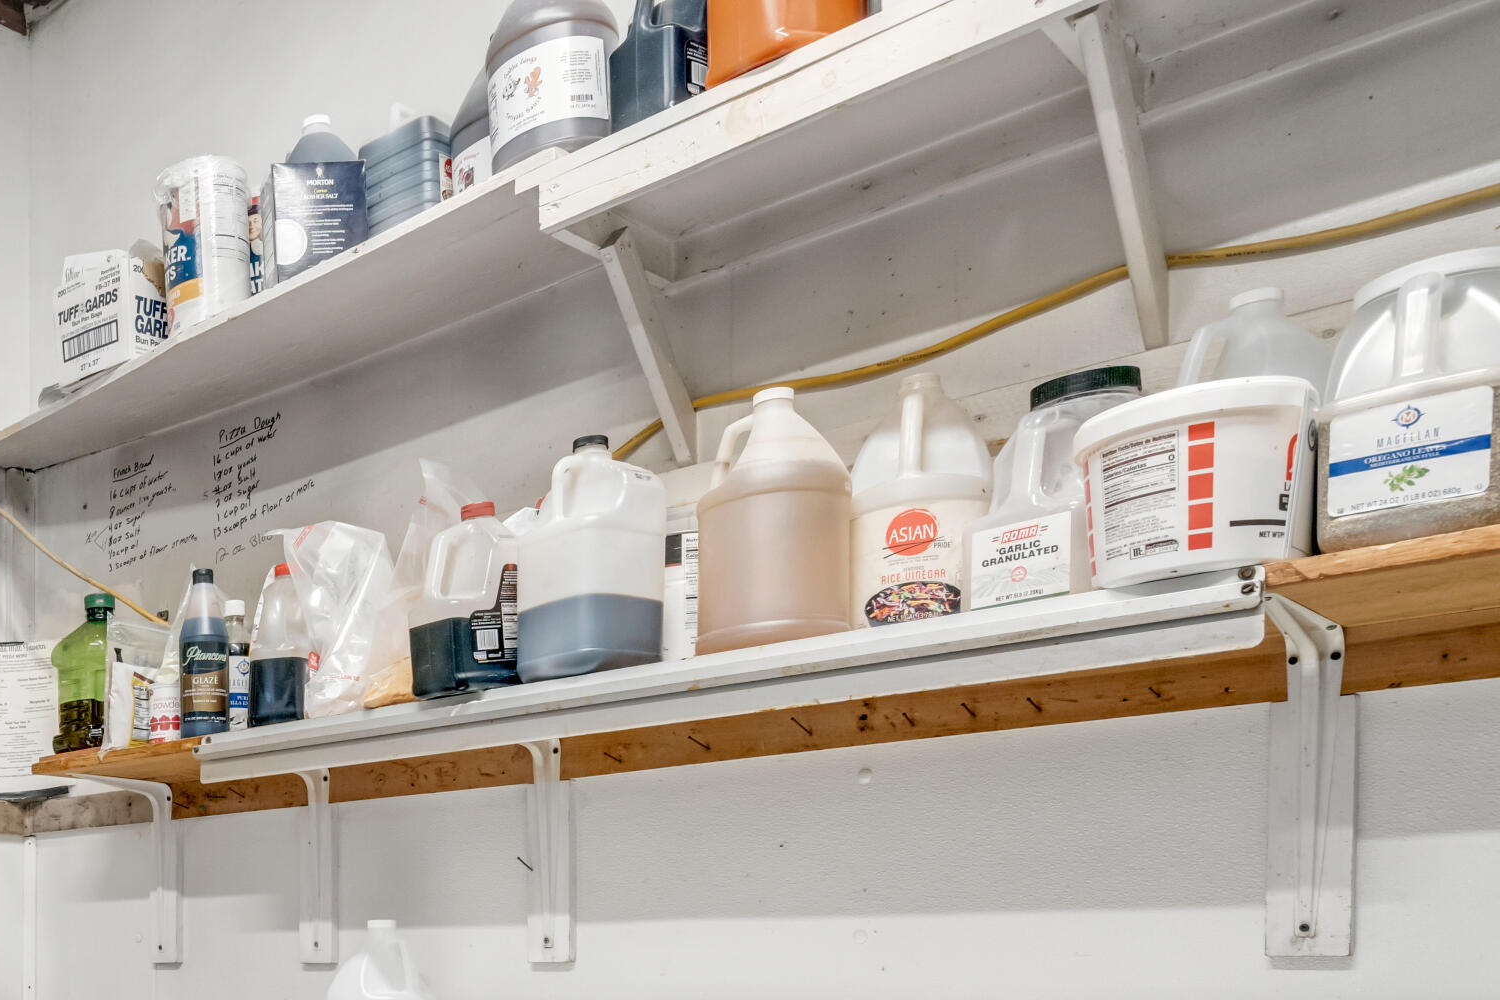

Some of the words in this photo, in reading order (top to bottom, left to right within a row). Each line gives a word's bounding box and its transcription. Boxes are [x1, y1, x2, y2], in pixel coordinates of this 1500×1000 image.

[165, 245, 187, 263] KER
[58, 304, 79, 325] TUFF
[85, 288, 118, 313] GARDS
[135, 295, 167, 319] TUFF
[135, 315, 168, 339] GARD
[136, 335, 148, 345] Bun
[254, 411, 281, 431] Dough
[1376, 427, 1441, 448] MAGELLAN
[1364, 447, 1410, 464] OREGANO
[1351, 502, 1364, 511] NET
[888, 523, 934, 544] ASIAN
[1002, 526, 1038, 543] ROMA
[999, 539, 1041, 555] GARLIC
[981, 545, 1059, 567] GRANULATED
[881, 573, 901, 584] RICE
[905, 569, 946, 581] VINEGAR
[192, 676, 219, 685] GLAZE
[152, 699, 180, 710] powde
